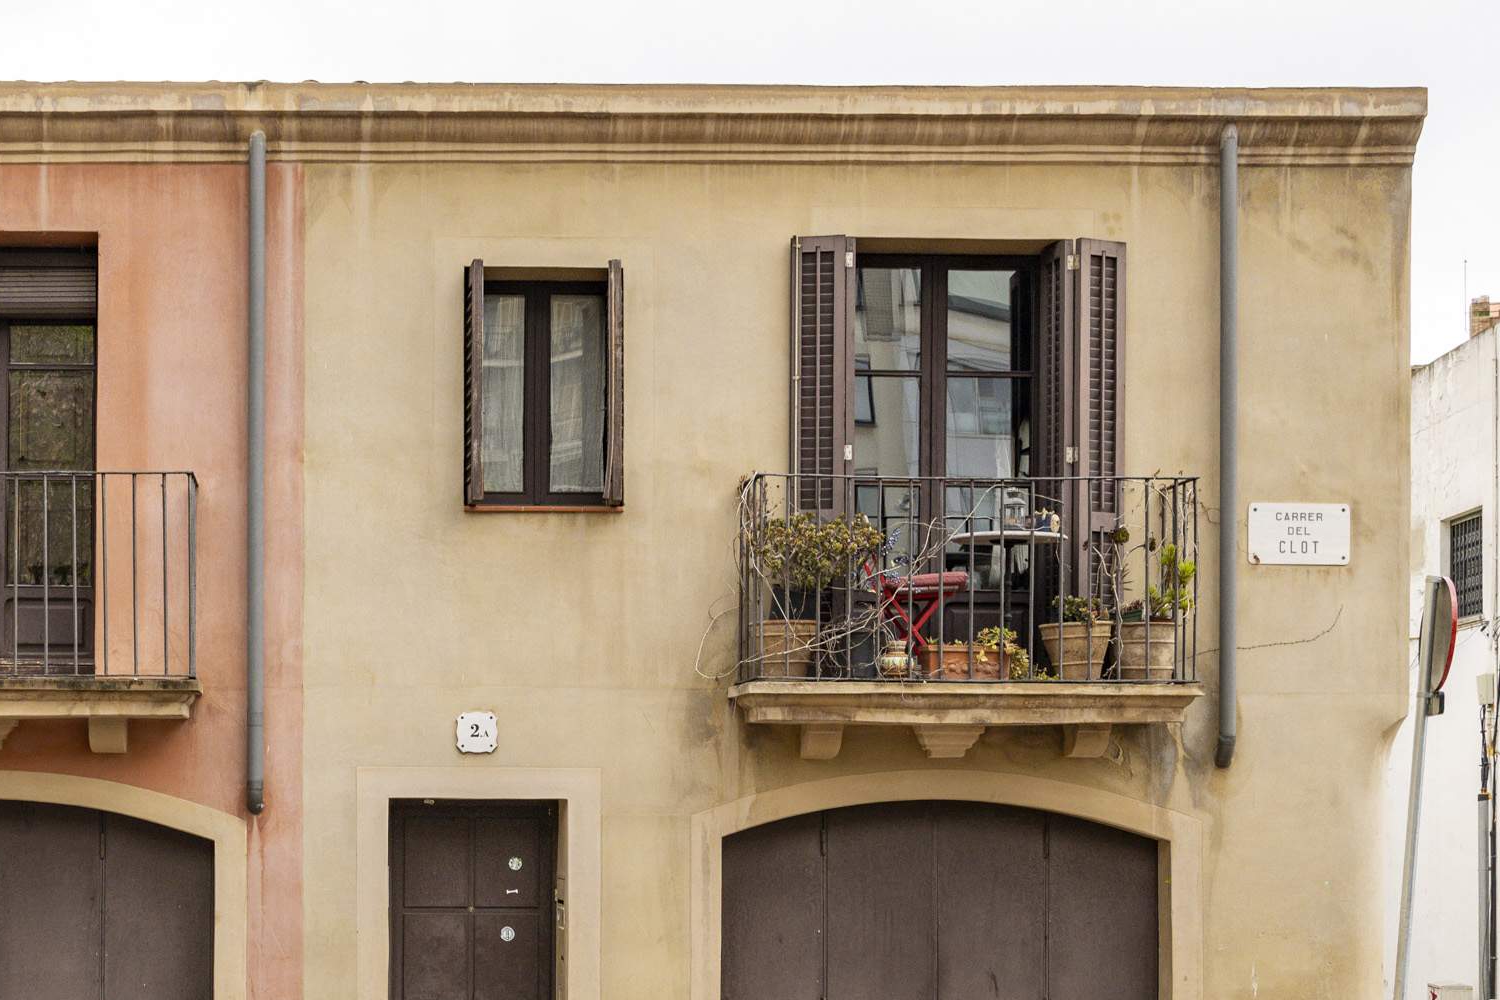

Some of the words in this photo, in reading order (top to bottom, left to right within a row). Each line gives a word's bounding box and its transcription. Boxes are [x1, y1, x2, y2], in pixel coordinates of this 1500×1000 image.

[1275, 512, 1323, 521] CARRER
[1287, 526, 1311, 536] DEL
[1279, 540, 1319, 554] CLOT
